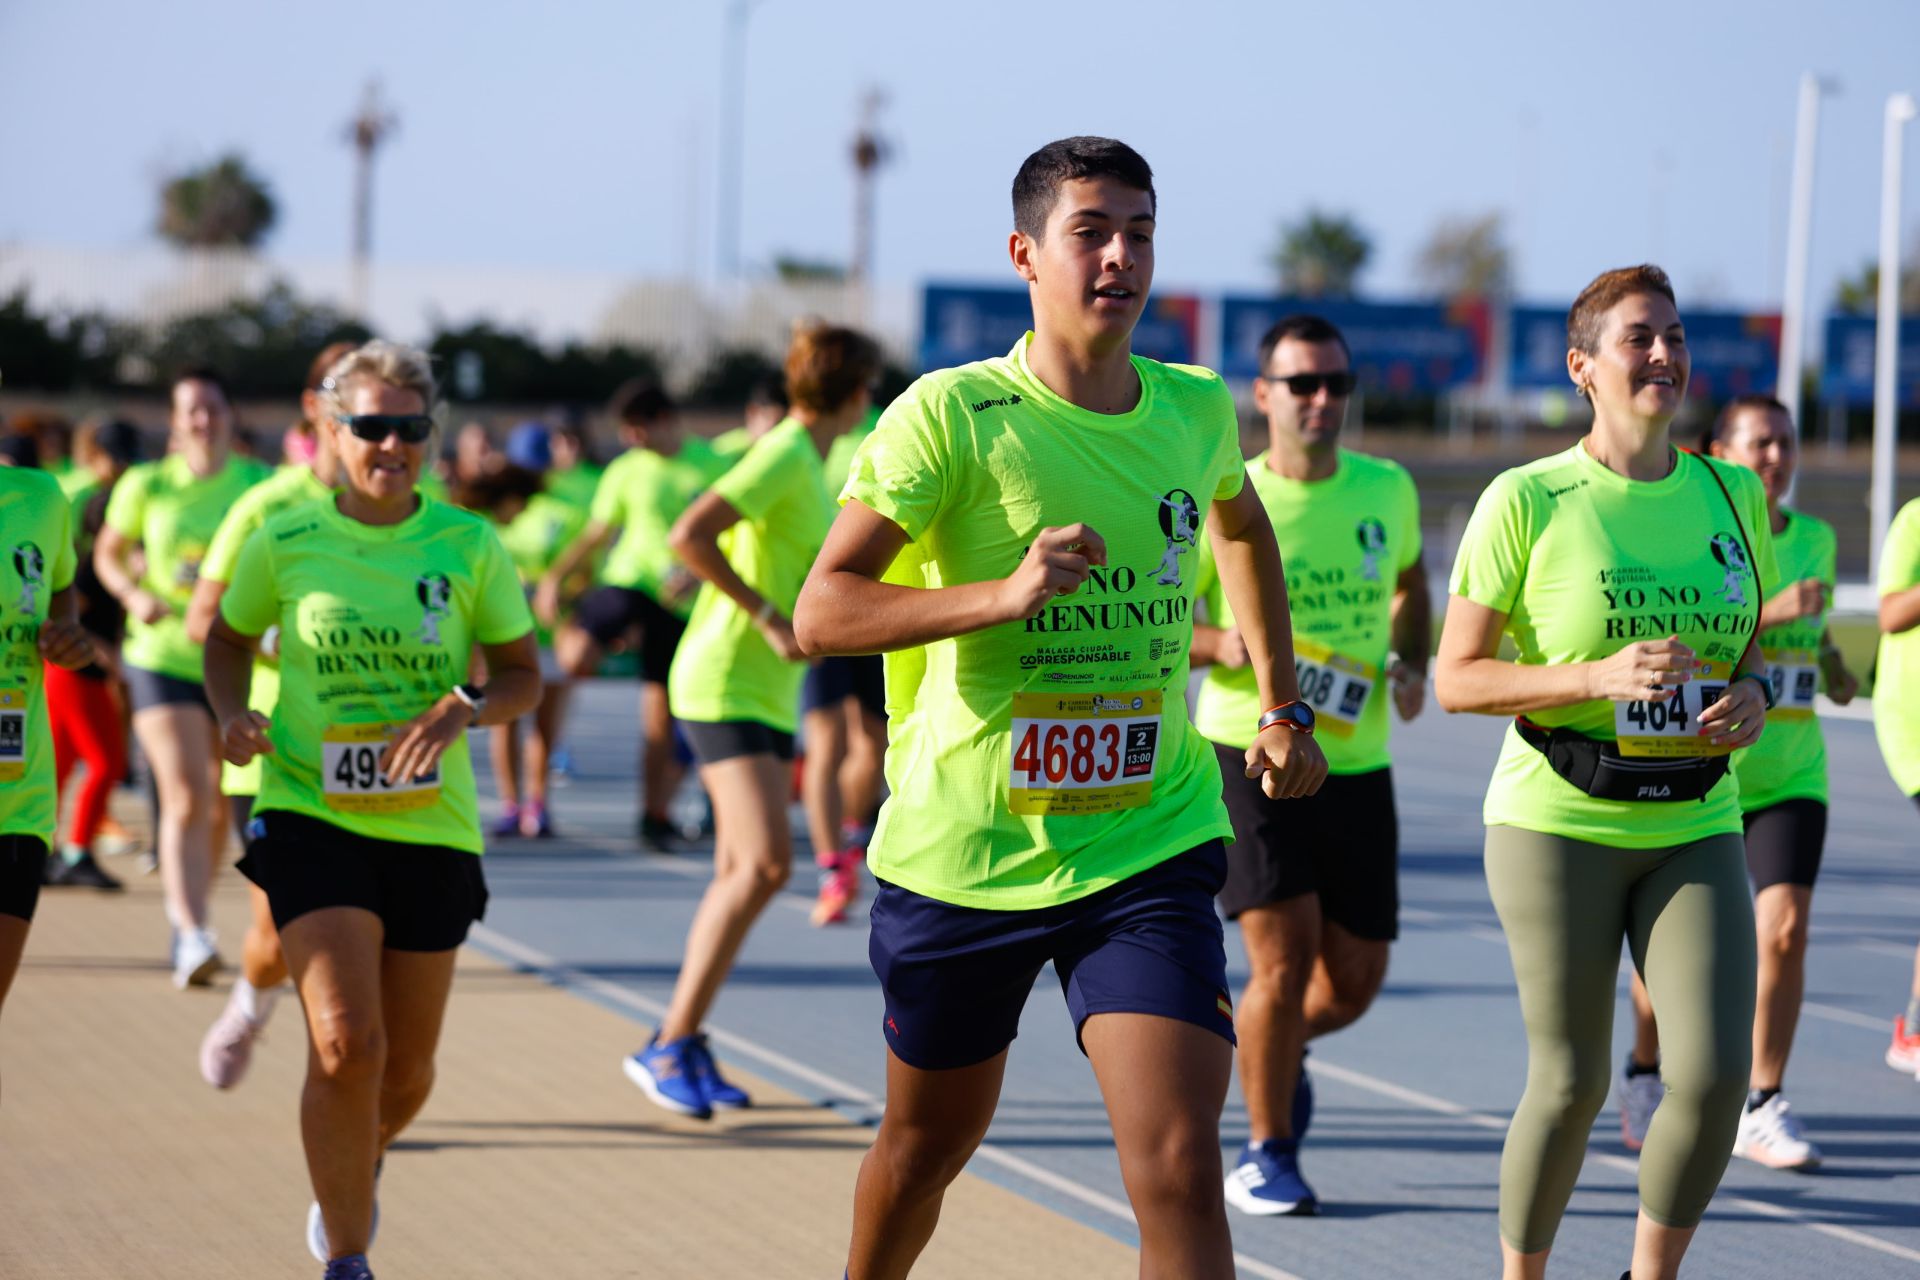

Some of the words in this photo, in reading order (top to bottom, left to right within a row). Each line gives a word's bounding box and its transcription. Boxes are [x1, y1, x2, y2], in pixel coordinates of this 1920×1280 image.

[971, 397, 1009, 413] luanvi
[1085, 566, 1136, 595] NO
[1601, 587, 1646, 610] YO
[1658, 585, 1701, 607] NO
[1024, 595, 1188, 633] RENUNCIO
[1605, 612, 1753, 640] RENUNCIO
[313, 627, 350, 649] YO
[360, 625, 401, 647] NO
[1079, 644, 1114, 653] CIUDAD
[316, 651, 449, 677] RENUNCIO
[1019, 651, 1132, 666] CORRESPONSABLE
[1296, 662, 1334, 705] 08
[1136, 731, 1147, 747] 2
[1013, 723, 1121, 783] 4683
[1126, 752, 1151, 765] 13:00
[1637, 784, 1671, 798] FILA
